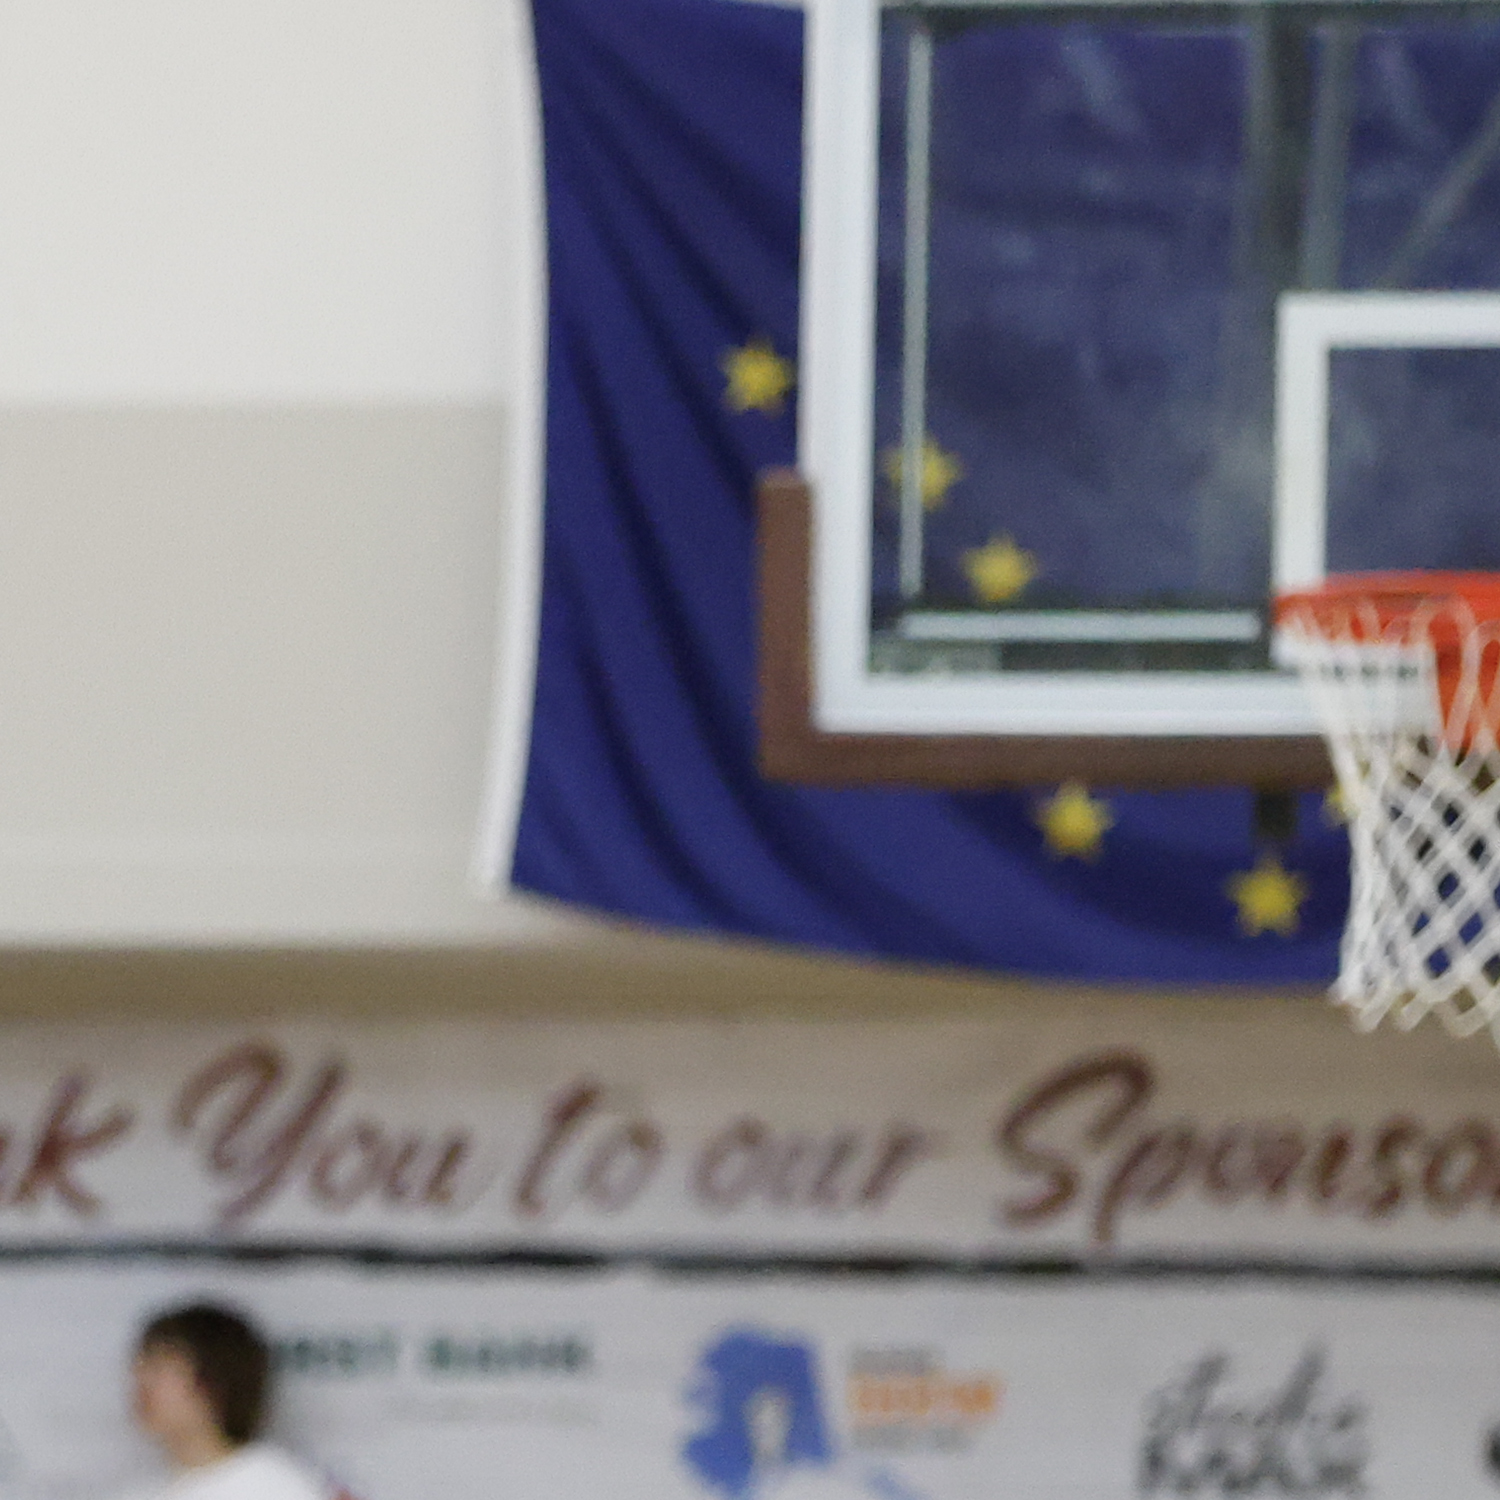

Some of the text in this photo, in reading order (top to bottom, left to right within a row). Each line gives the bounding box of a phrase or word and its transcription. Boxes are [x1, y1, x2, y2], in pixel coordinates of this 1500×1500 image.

[168, 1038, 475, 1238] You
[515, 1070, 665, 1215] to
[995, 1045, 1500, 1256] Sponso
